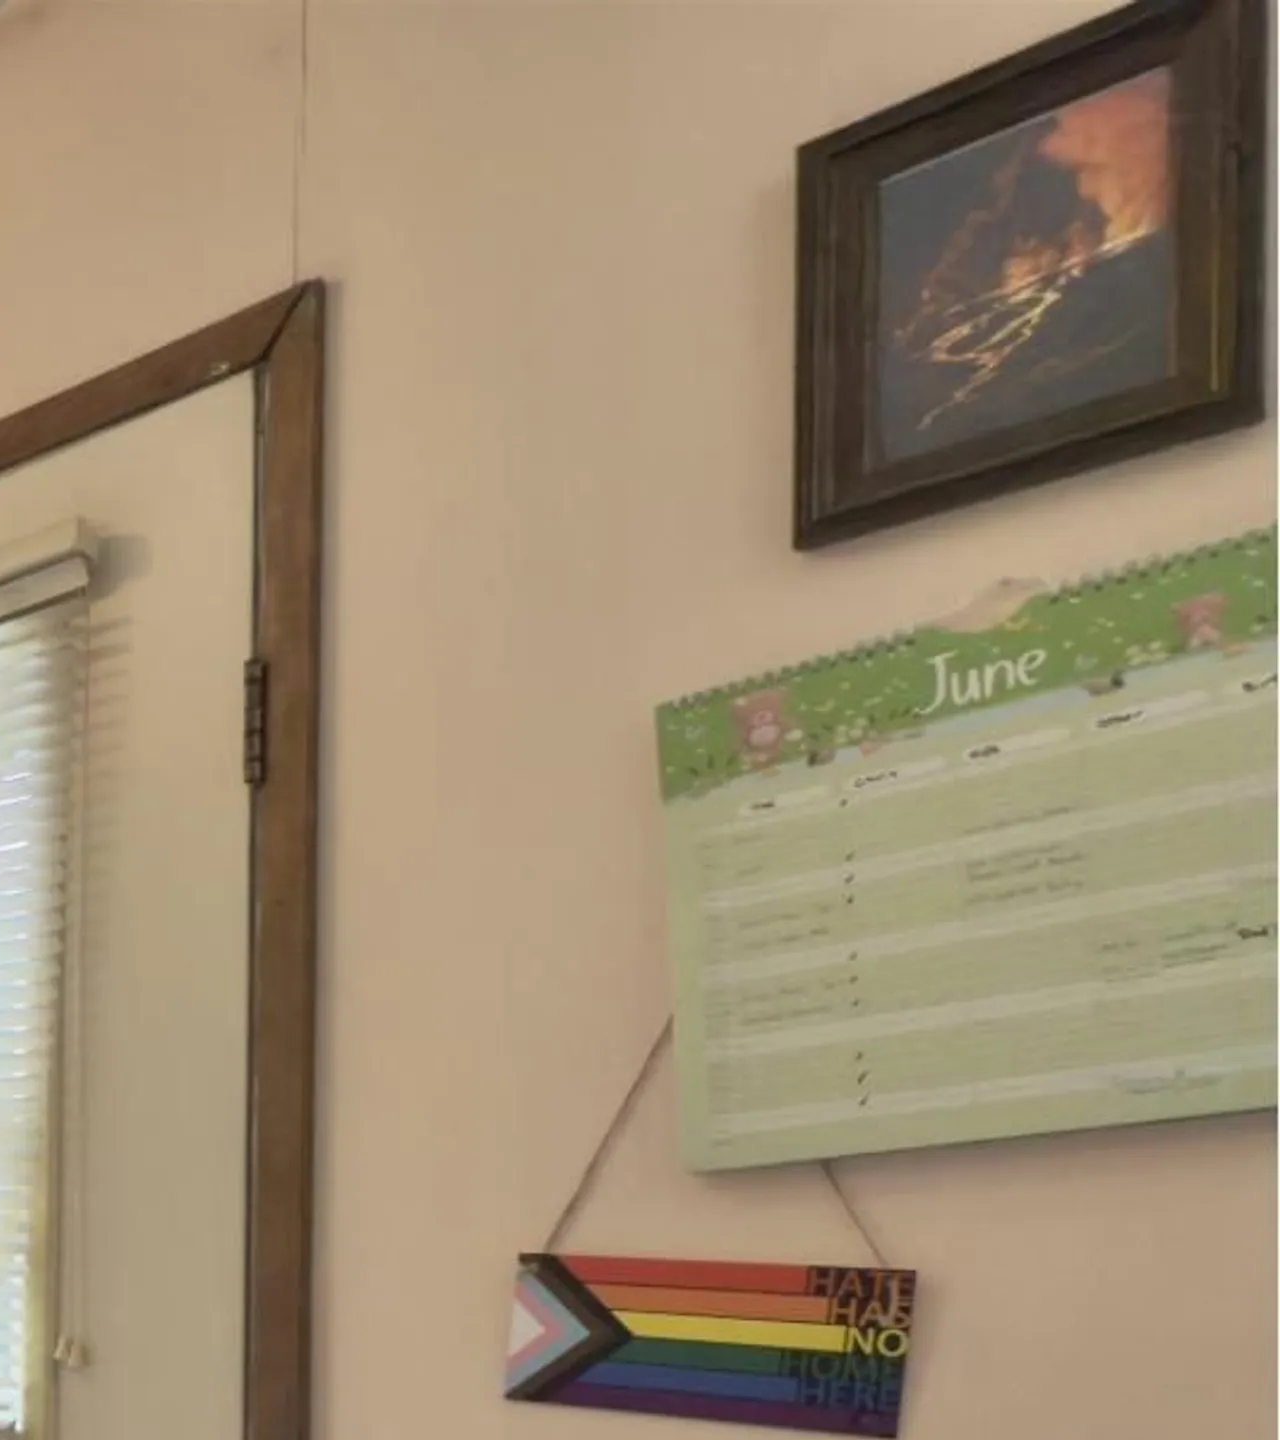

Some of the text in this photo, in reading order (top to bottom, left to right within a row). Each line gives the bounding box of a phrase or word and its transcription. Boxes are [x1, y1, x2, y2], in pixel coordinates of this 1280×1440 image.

[912, 648, 1048, 715] June
[808, 1268, 915, 1301] HATE
[829, 1297, 913, 1329] HAS
[846, 1326, 909, 1357] NO
[800, 1378, 898, 1411] HERE
